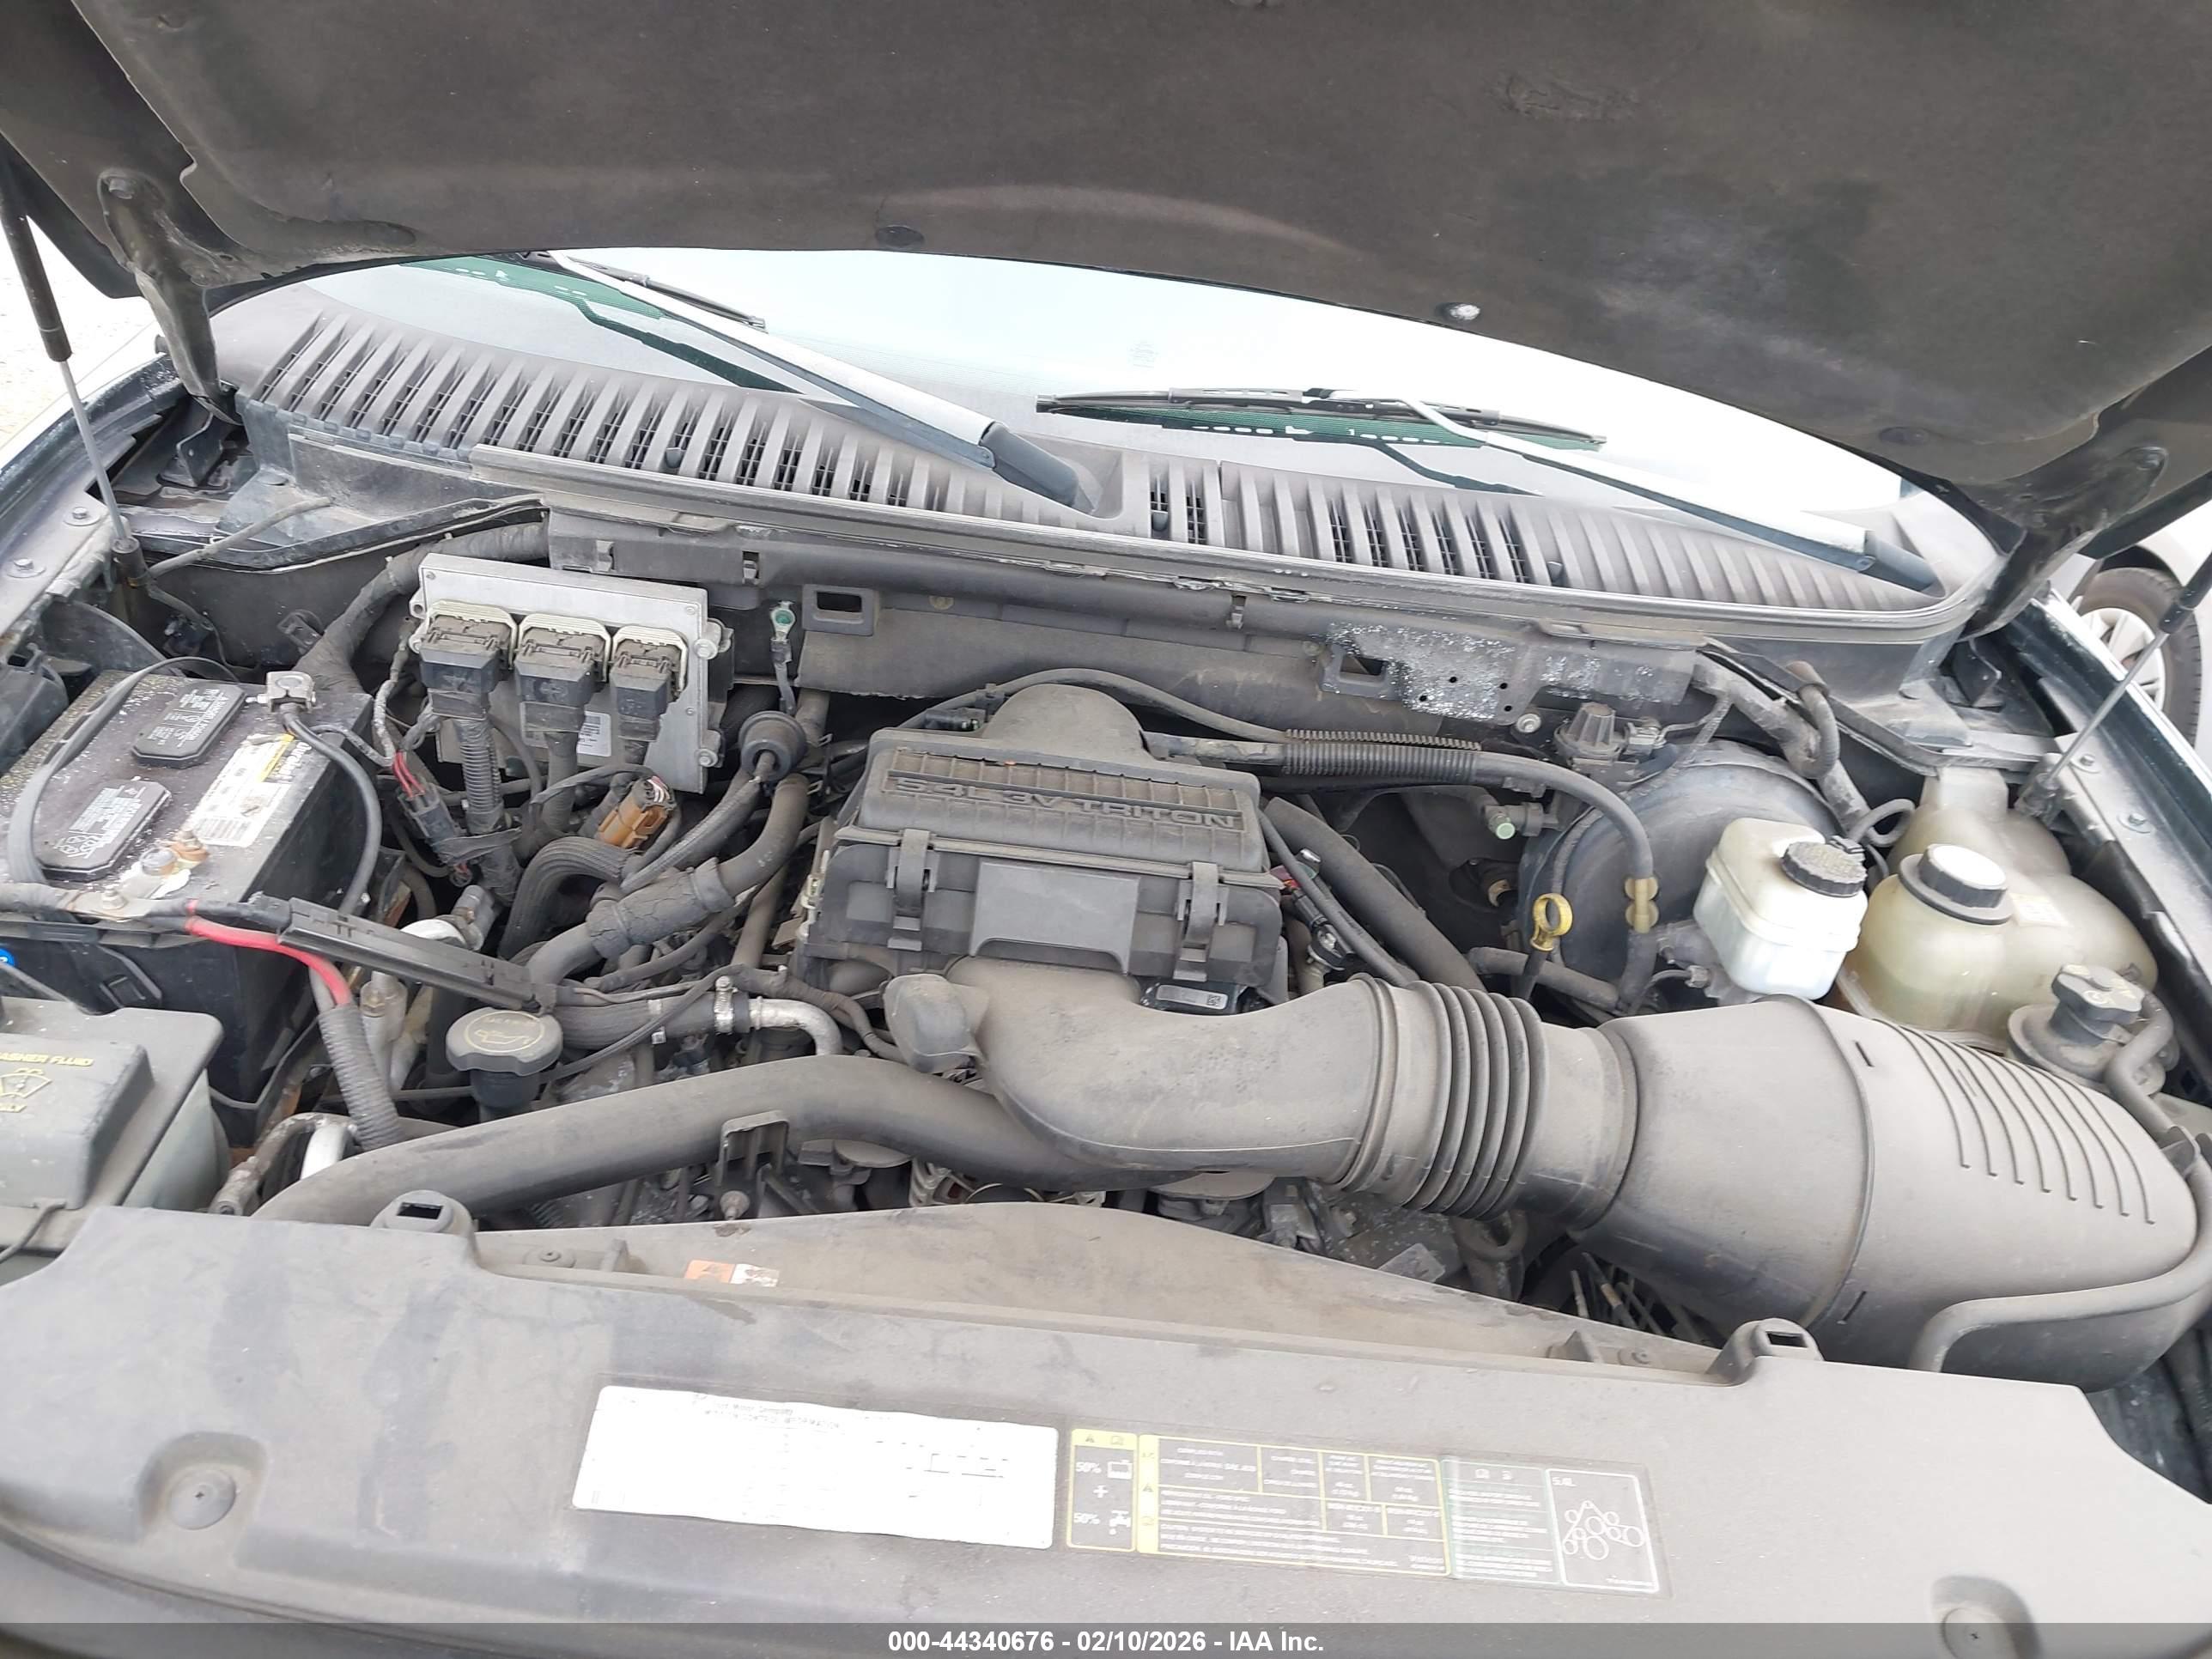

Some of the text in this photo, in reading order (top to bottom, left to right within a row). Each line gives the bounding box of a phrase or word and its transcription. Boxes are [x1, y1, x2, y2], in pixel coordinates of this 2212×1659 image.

[896, 777, 1236, 828] 5.4L 3V TRITON
